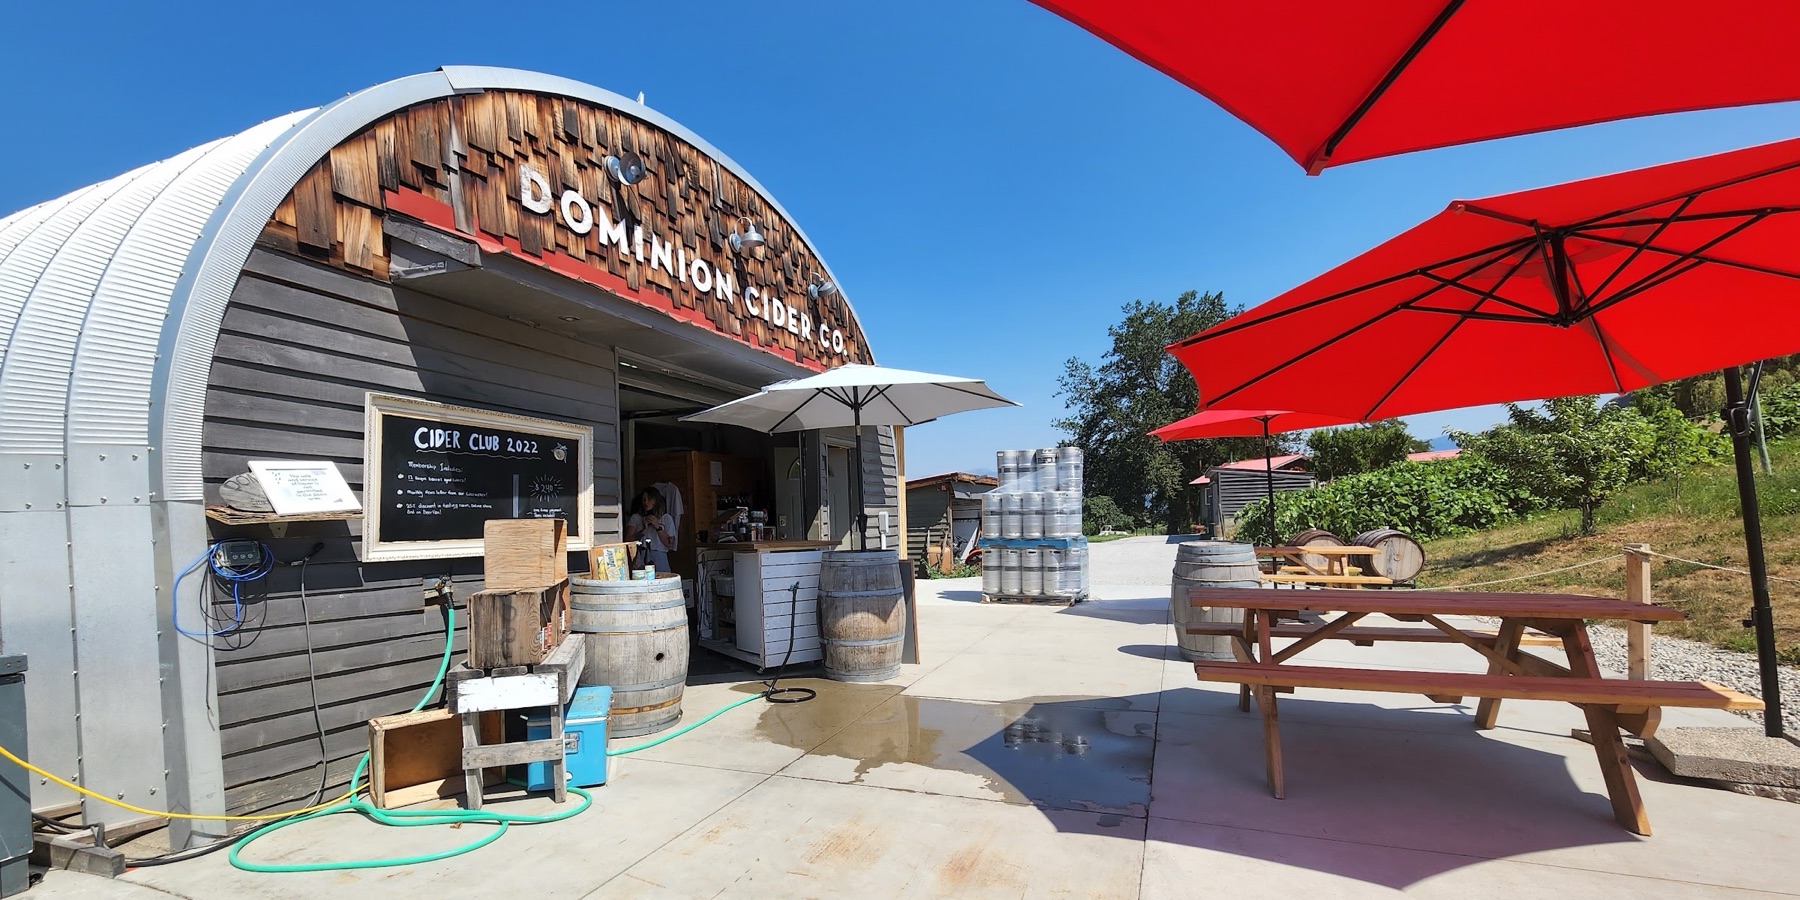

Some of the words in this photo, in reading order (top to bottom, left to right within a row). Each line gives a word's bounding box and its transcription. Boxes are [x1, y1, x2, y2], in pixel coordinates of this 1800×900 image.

[518, 162, 734, 305] DOMINION
[745, 286, 811, 342] CIDER
[819, 323, 848, 356] CO.
[414, 426, 461, 449] CIDER
[469, 433, 500, 451] CLUB
[507, 437, 539, 454] 2022
